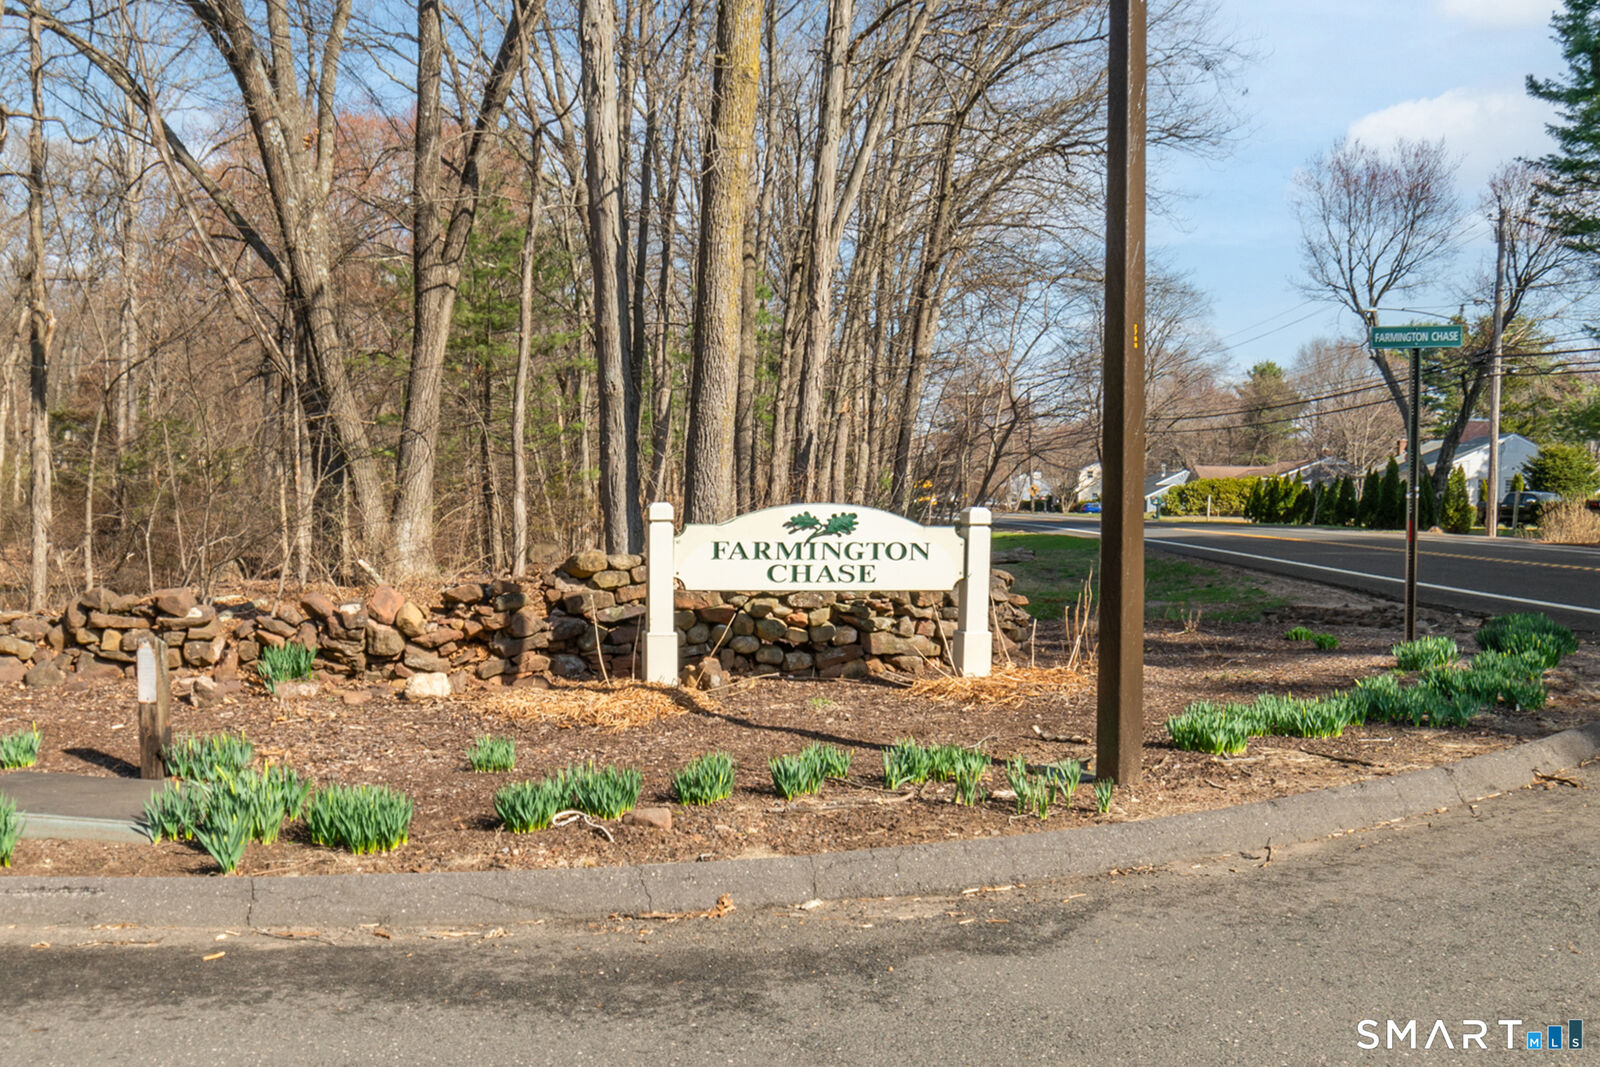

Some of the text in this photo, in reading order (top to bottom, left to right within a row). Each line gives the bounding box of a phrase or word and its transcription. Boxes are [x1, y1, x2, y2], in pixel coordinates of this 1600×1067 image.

[1374, 330, 1459, 343] FARMINGTON CHASE
[711, 541, 930, 561] FARMINGTON
[767, 564, 877, 584] CHASE
